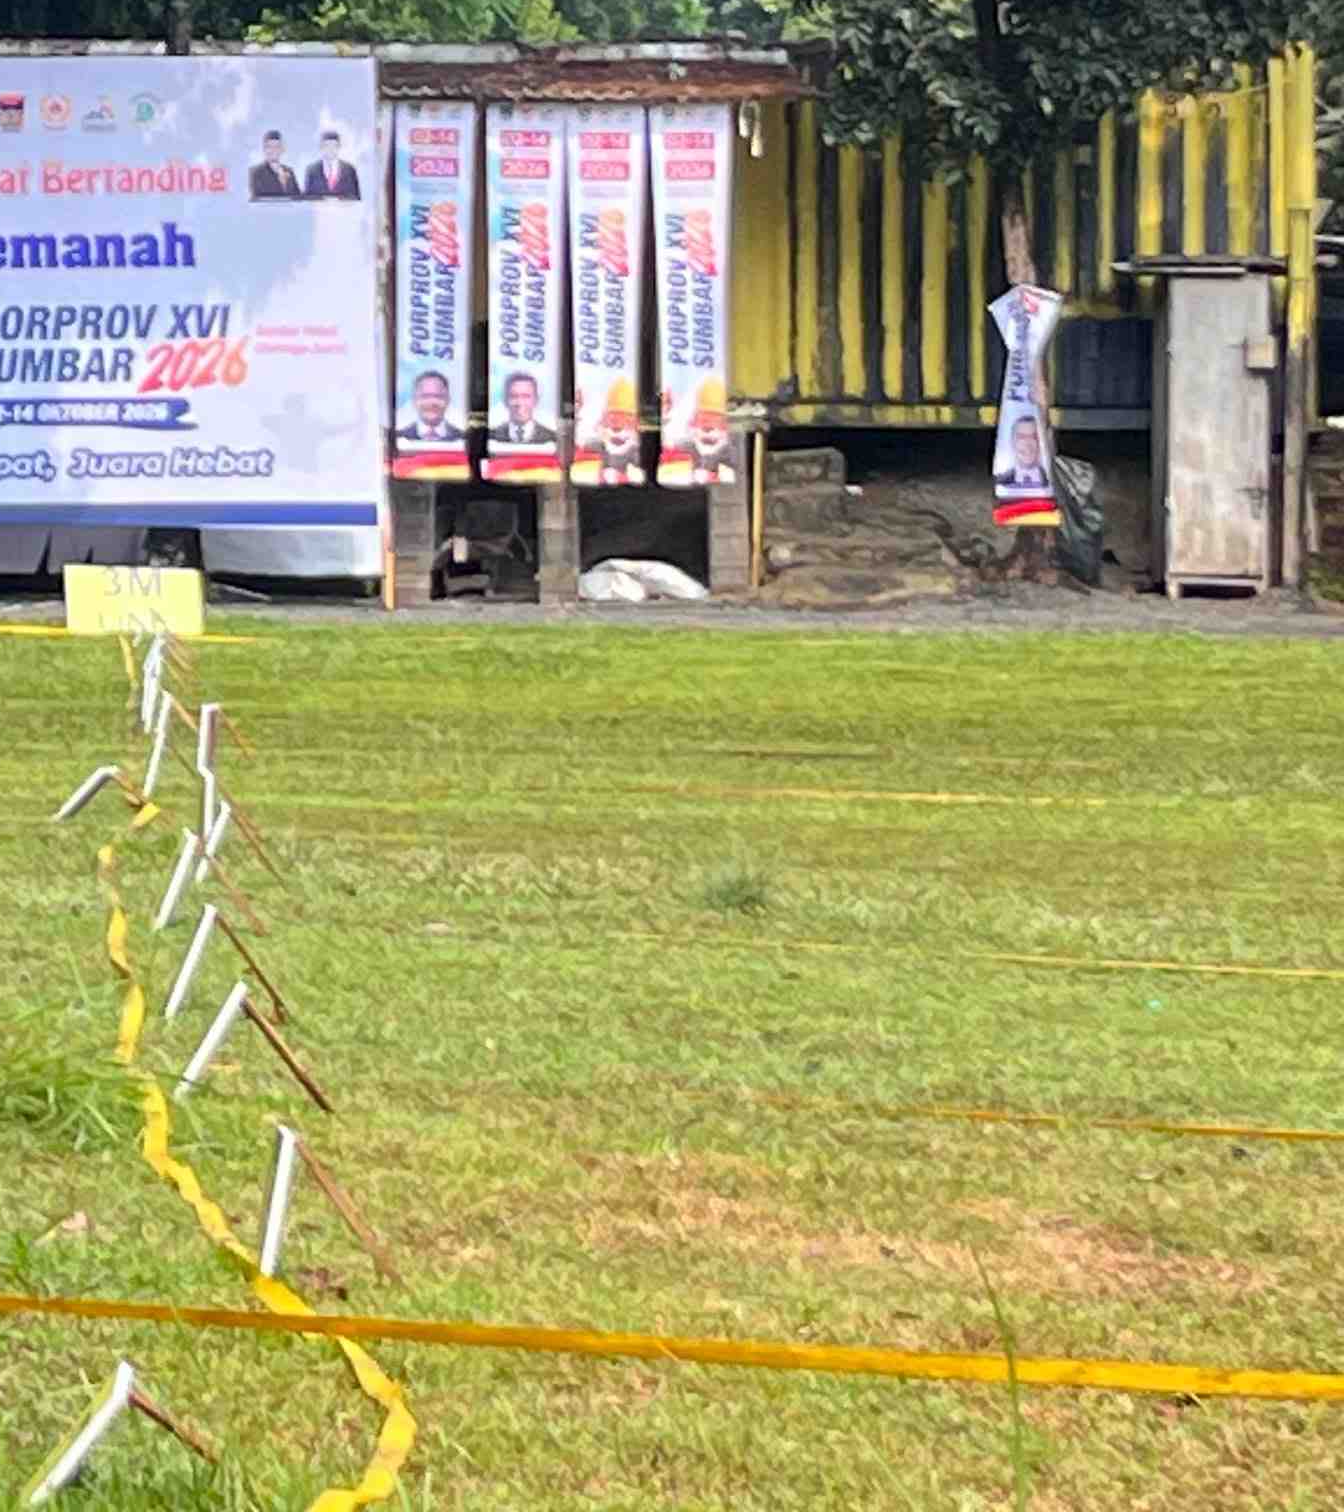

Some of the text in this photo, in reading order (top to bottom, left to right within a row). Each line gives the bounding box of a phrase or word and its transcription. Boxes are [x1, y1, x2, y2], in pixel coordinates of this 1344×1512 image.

[42, 161, 229, 196] Bertanding
[409, 248, 432, 357] PORPROV
[165, 304, 231, 340] XVI
[138, 338, 249, 395] 2026
[67, 448, 165, 479] Juara
[169, 447, 275, 479] Hebat
